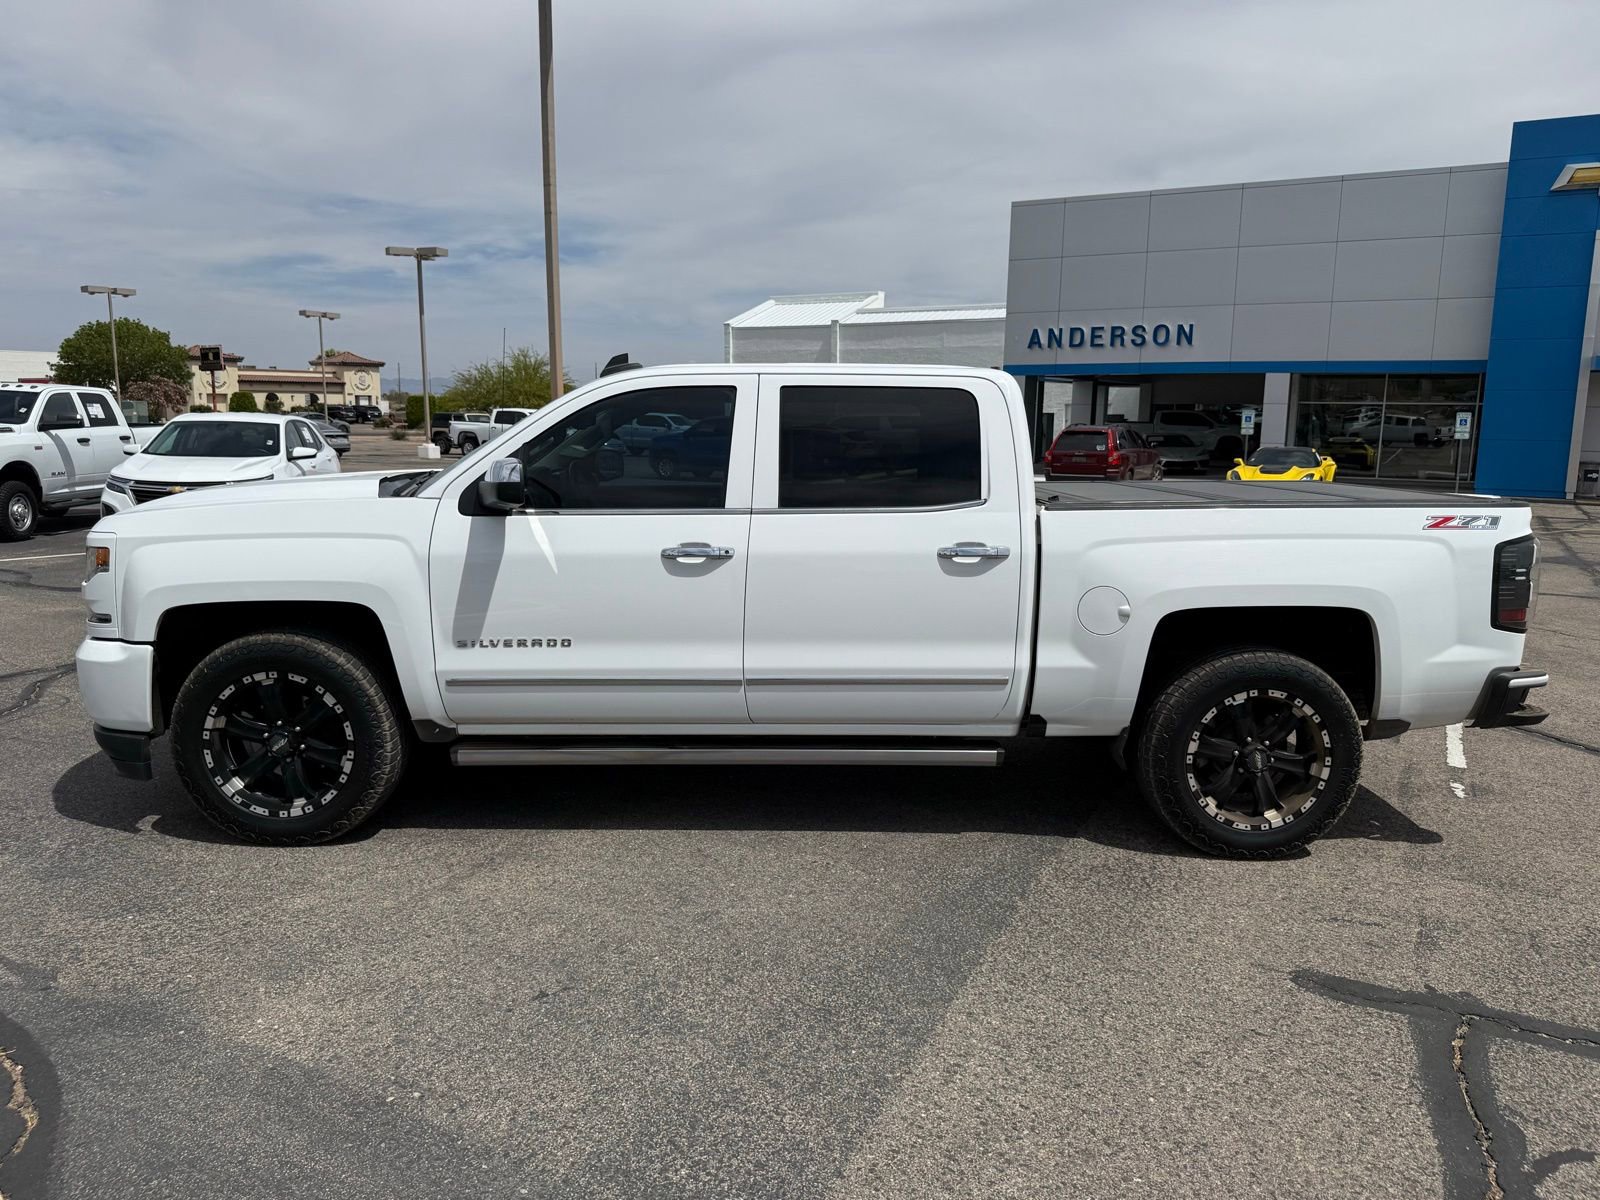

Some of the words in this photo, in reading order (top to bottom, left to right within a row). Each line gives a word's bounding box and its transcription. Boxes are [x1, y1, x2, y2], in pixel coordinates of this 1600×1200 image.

[1027, 323, 1194, 349] ANDERSON
[1422, 515, 1501, 531] Z71
[456, 639, 572, 649] SILVERADO
